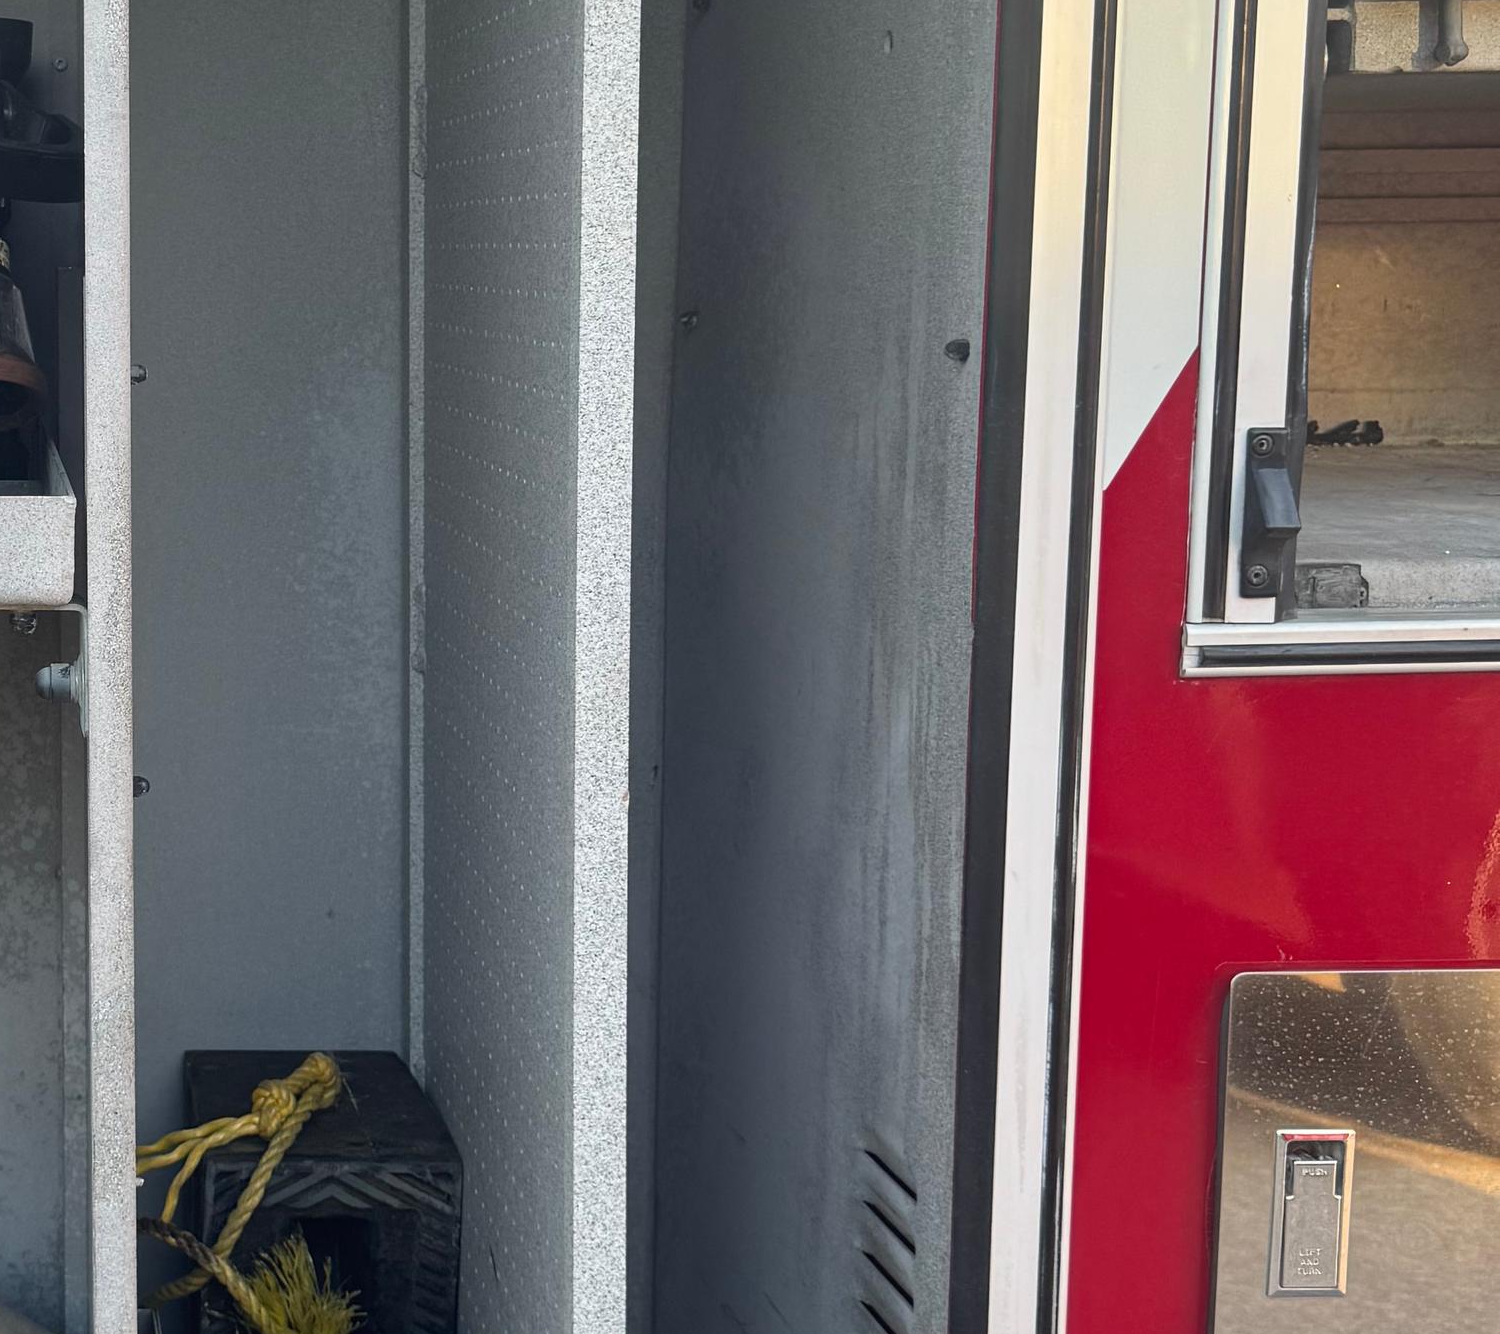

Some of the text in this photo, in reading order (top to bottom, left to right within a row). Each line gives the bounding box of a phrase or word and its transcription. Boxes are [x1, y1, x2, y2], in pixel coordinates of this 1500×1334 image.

[1301, 1168, 1328, 1177] PUSH
[1299, 1248, 1322, 1257] LIFT
[1297, 1267, 1323, 1275] TURN
